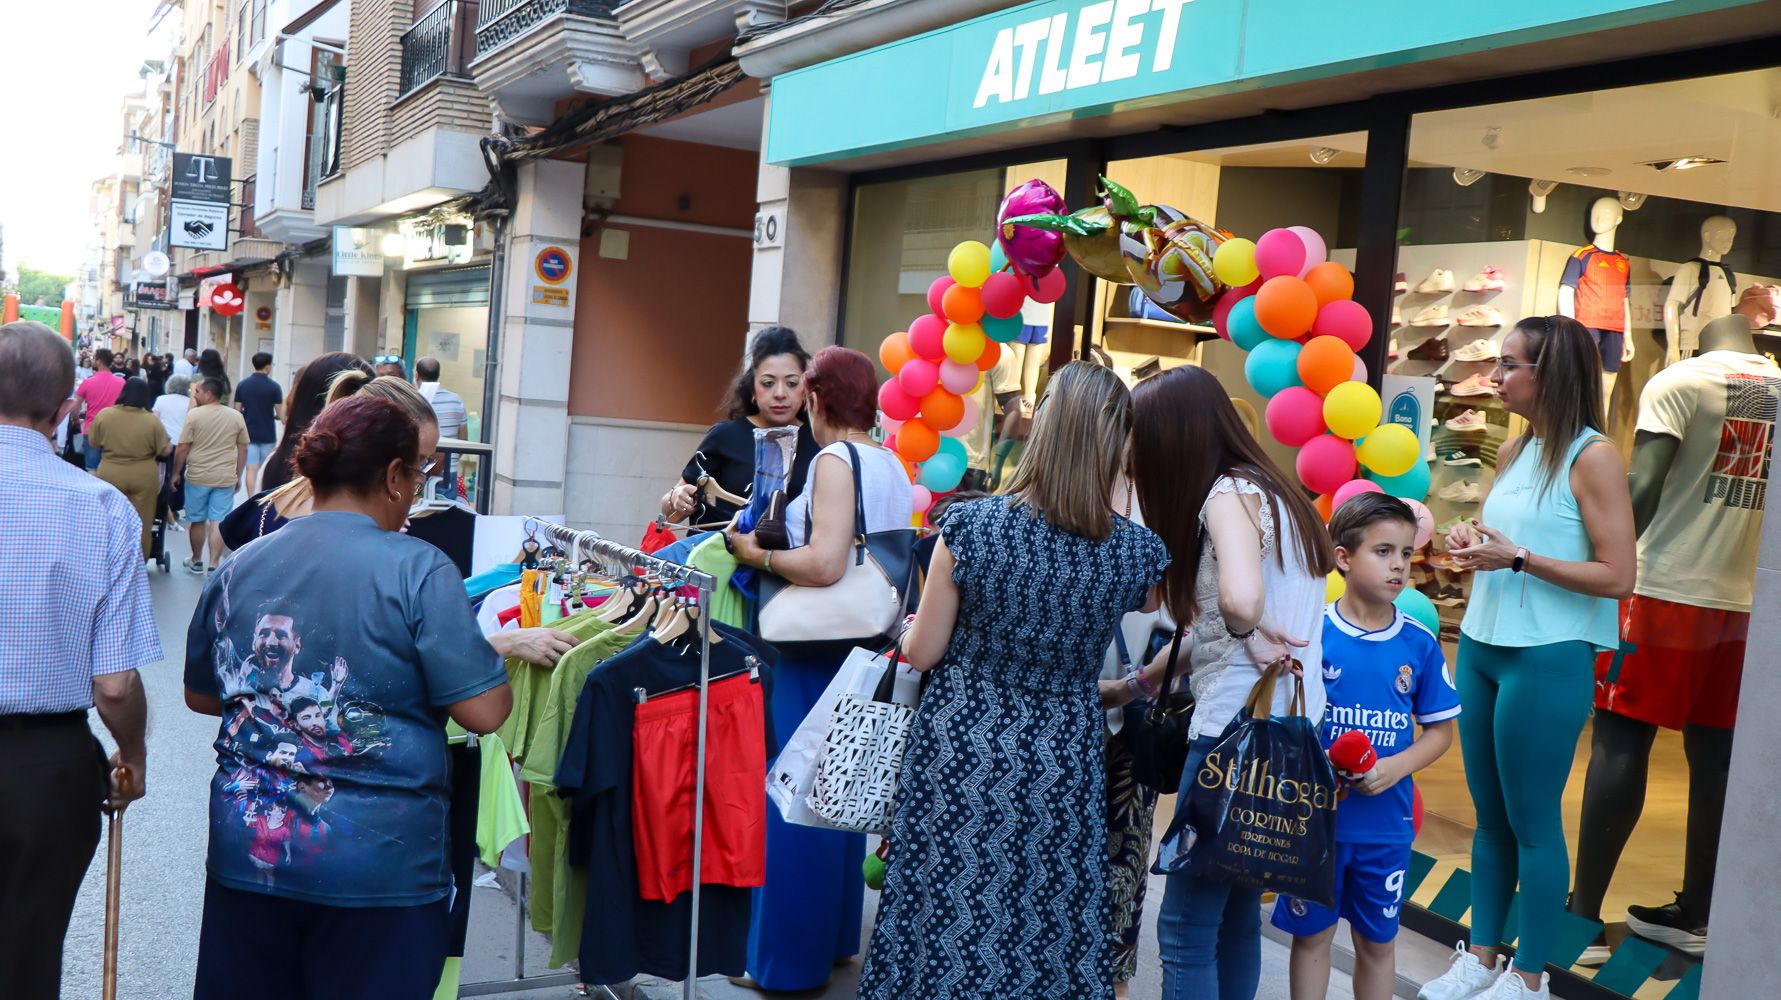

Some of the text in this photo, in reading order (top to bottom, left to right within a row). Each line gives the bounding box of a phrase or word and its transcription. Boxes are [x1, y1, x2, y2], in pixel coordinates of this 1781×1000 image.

[972, 0, 1195, 109] ATLEET
[754, 215, 777, 243] 30
[1703, 475, 1767, 511] PUM
[1325, 703, 1409, 730] Emirates
[1357, 728, 1397, 747] ETTER
[1227, 842, 1252, 856] ROPA
[1253, 848, 1267, 860] DE
[1385, 869, 1406, 904] 9
